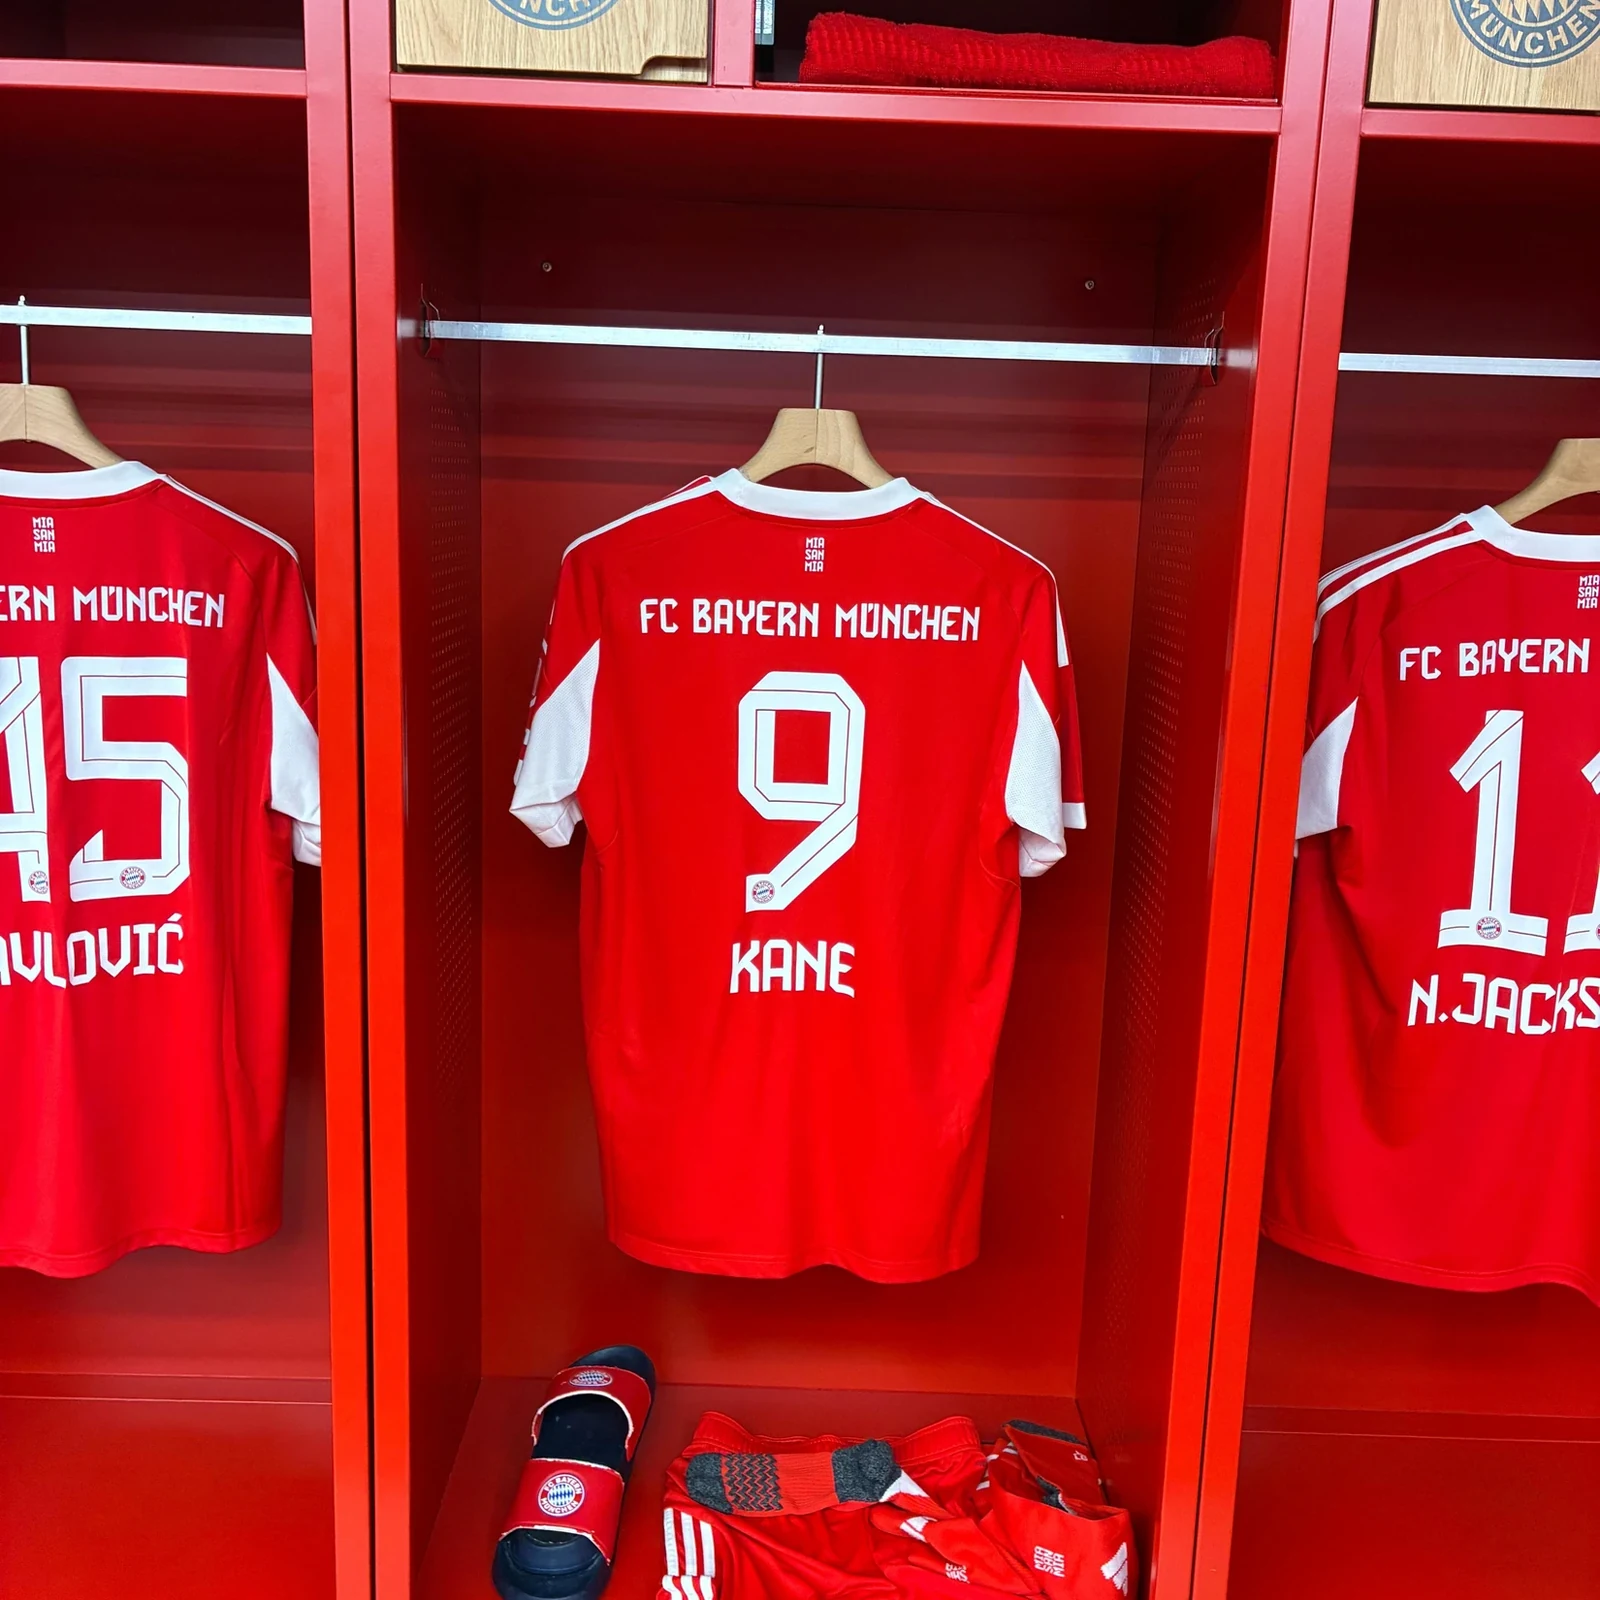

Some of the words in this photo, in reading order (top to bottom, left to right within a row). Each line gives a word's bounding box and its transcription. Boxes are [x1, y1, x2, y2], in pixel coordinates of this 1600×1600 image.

[32, 516, 54, 529] MIA
[32, 528, 55, 541] SAN
[33, 540, 56, 553] MIA
[805, 536, 825, 549] MIA
[804, 548, 825, 561] SAN
[804, 560, 824, 572] MIA
[1579, 574, 1600, 587] MIA
[1578, 586, 1600, 598] SAN
[73, 585, 225, 628] MÜNCHEN
[1577, 597, 1598, 609] MIA
[640, 598, 679, 633] FC
[692, 598, 820, 638] BAYERN
[835, 602, 981, 641] MÜNCHEN
[1399, 645, 1442, 682] FC
[1458, 637, 1591, 677] BAYERN
[738, 671, 865, 912] 9
[729, 939, 856, 998] KANE
[1052, 1552, 1065, 1578] MIA
